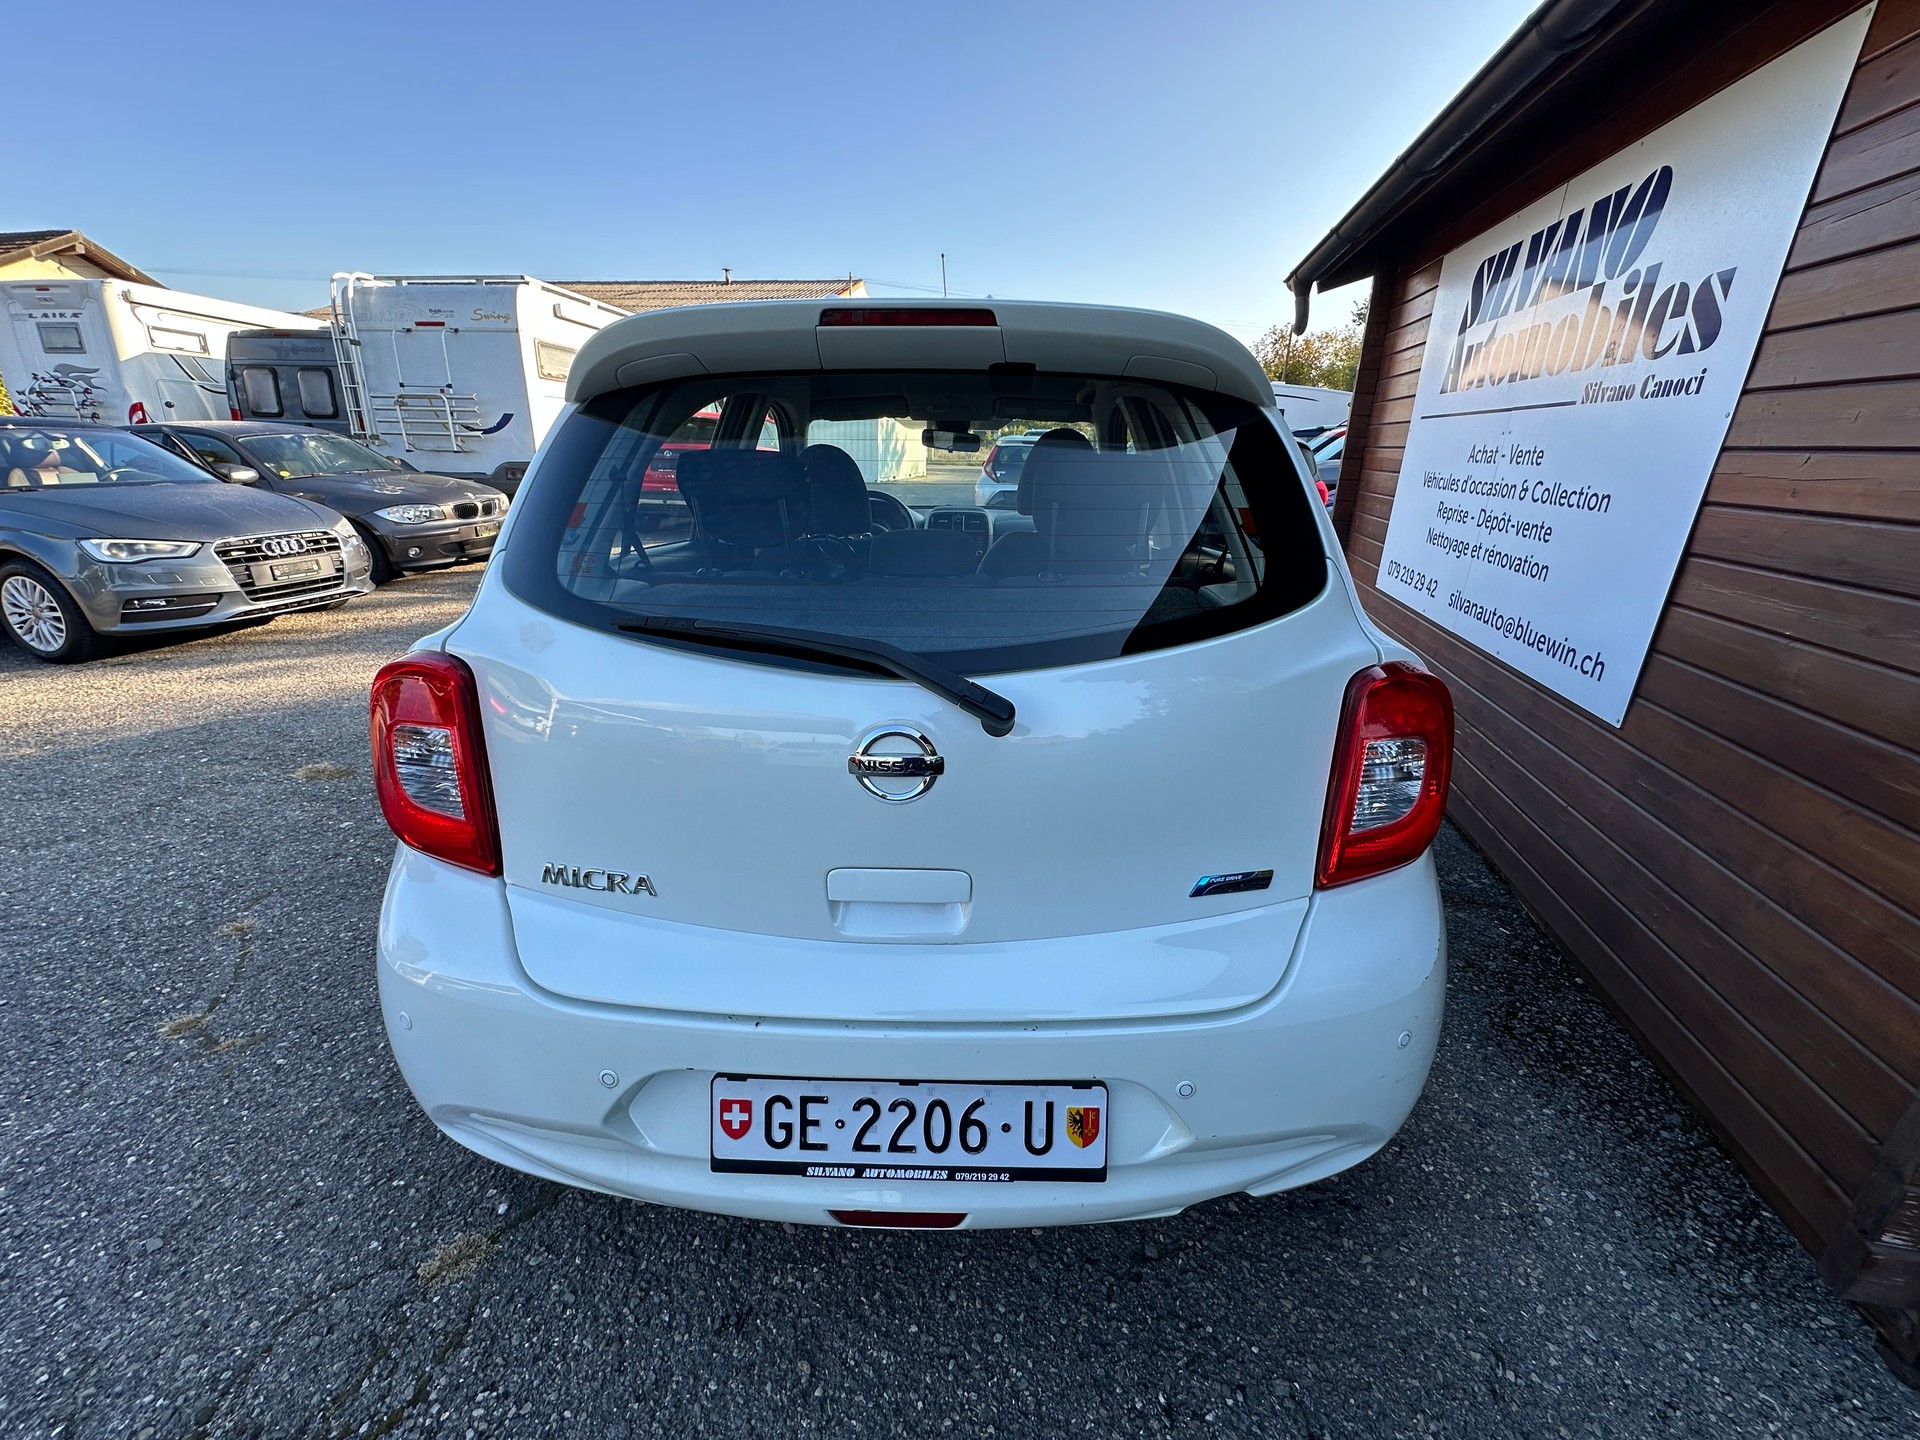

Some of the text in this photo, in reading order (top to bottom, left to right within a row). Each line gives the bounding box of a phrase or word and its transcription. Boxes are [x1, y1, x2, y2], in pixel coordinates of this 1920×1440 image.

[1457, 165, 1674, 337] SILVANO
[470, 308, 512, 323] Swing
[1440, 262, 1738, 395] Automobiles
[1580, 367, 1708, 405] Silvano Canoci
[1467, 444, 1500, 465] Achat
[1508, 443, 1545, 466] Vente
[1422, 471, 1461, 493] Véhicules
[1518, 479, 1529, 502] &
[1531, 480, 1612, 513] Collection
[1436, 500, 1469, 525] Reprise
[1476, 508, 1553, 543] Dépôt-vente
[1425, 527, 1550, 582] Nettoyage et rénovation
[1387, 559, 1606, 683] 079 219 29 42 silvanauto@bluewin.ch
[857, 759, 934, 774] NISSAN
[541, 861, 658, 897] MICRA
[806, 1166, 1010, 1181] SILVANO AUTOMOBILES 079/219 29 42
